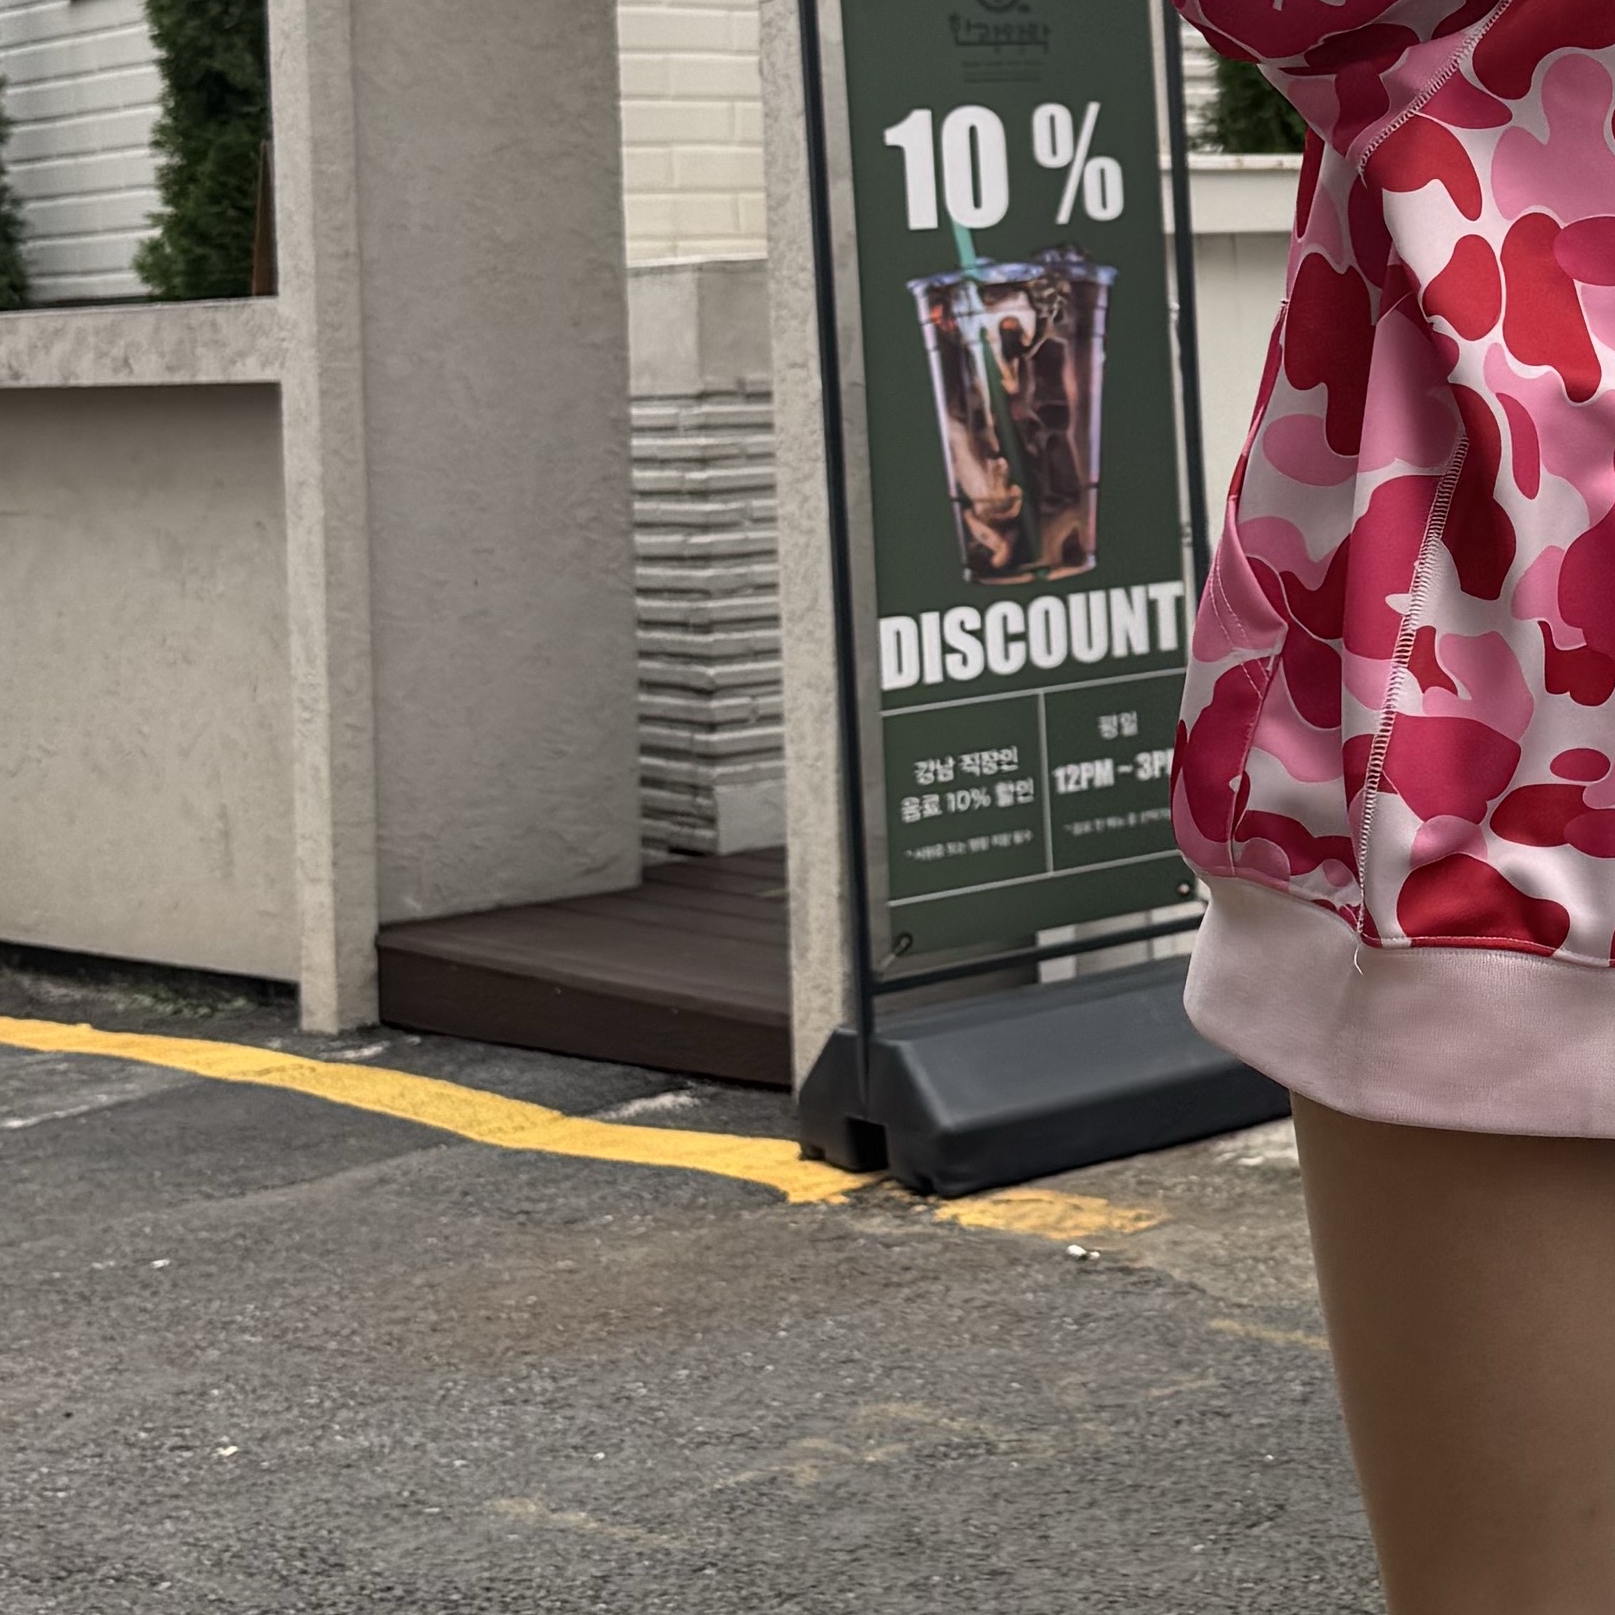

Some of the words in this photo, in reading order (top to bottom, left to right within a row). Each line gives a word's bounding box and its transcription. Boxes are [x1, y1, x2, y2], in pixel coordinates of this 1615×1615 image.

[884, 104, 1010, 230] 10
[1031, 102, 1125, 224] %
[879, 581, 1184, 690] DISCOUNT
[1098, 711, 1138, 740] 평일
[914, 755, 955, 785] 강남
[959, 745, 1018, 776] 직장인
[1053, 758, 1115, 794] 12PM
[901, 794, 943, 823] 음료
[946, 787, 991, 812] 10%
